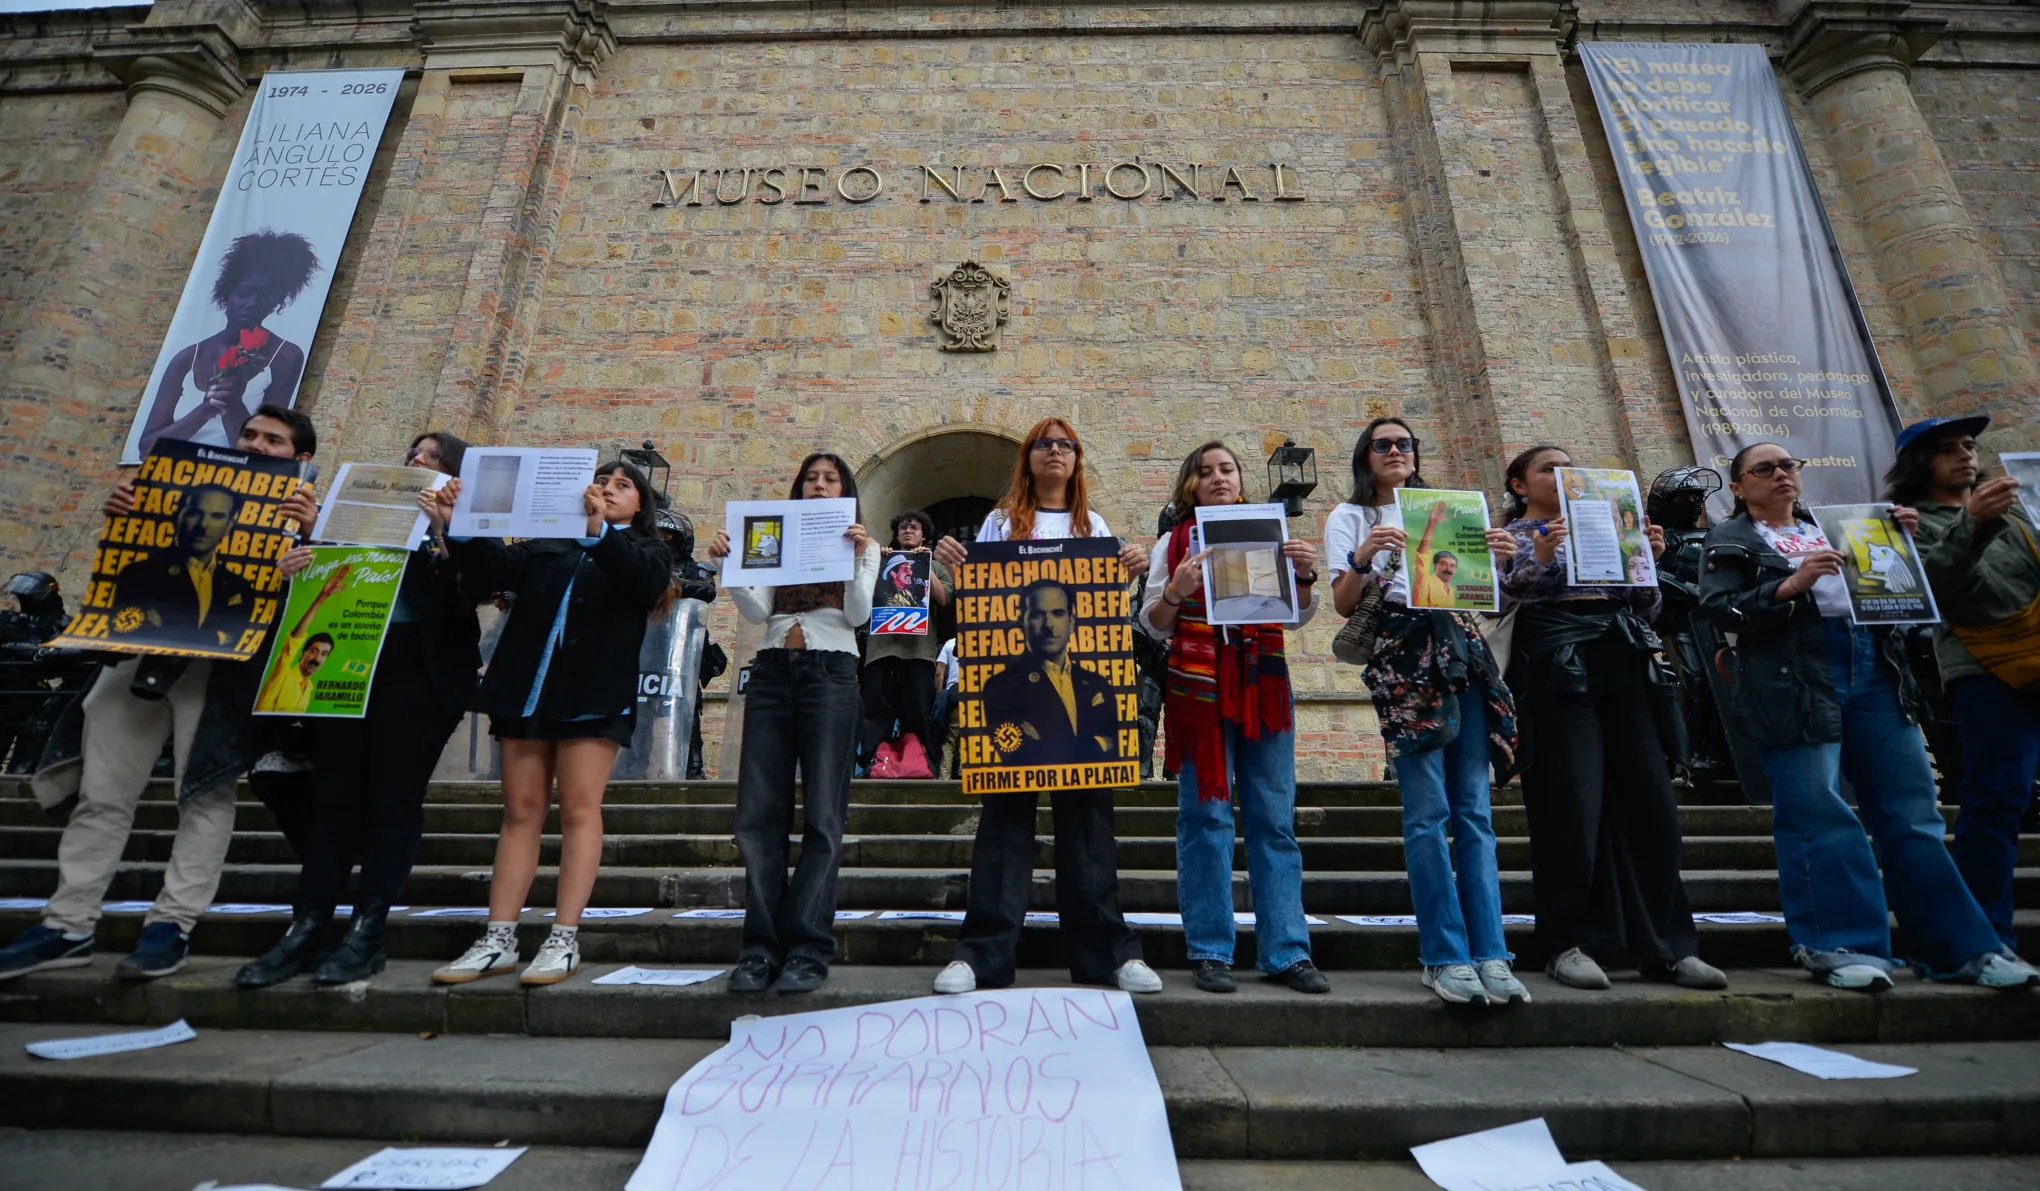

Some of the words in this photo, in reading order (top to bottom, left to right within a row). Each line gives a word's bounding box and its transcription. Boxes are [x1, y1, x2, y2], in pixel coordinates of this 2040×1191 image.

[1646, 60, 1732, 76] museo
[268, 85, 308, 98] 1974
[341, 83, 387, 95] 2026
[1606, 79, 1639, 93] no
[1646, 76, 1712, 94] debe
[1610, 95, 1732, 117] glorificar
[254, 121, 370, 145] LILIANA
[1617, 114, 1641, 134] el
[1650, 115, 1760, 137] pasado,
[1623, 133, 1680, 154] sino
[1686, 134, 1787, 155] hacerlo
[243, 143, 364, 168] ANGULO
[237, 163, 358, 191] CORTÉS
[652, 165, 885, 207] MUSEO
[919, 161, 1307, 204] NACIONAL
[1636, 186, 1742, 207] Beatriz
[1643, 207, 1776, 229] González
[1682, 352, 1731, 365] Artista
[1736, 352, 1801, 368] plástica,
[1686, 369, 1793, 385] investigadora,
[1797, 371, 1870, 386] pedagoga
[1691, 390, 1700, 402] y
[1705, 387, 1775, 401] curadora
[1779, 387, 1802, 400] del
[1806, 387, 1852, 401] Museo
[1695, 405, 1764, 419] Nacional
[1768, 405, 1789, 418] de
[1793, 405, 1864, 419] Colombia
[1701, 422, 1790, 438] (1989-2004)
[342, 609, 385, 619] Colombia
[356, 599, 389, 612] Porque
[354, 622, 382, 630] sueño
[337, 632, 349, 640] de
[316, 680, 366, 691] BERNARDO
[967, 771, 1020, 793] ¡FIRME
[1025, 769, 1057, 789] POR
[1062, 768, 1081, 787] LA
[1085, 765, 1135, 784] PLATA!
[724, 1025, 826, 1063] NO
[681, 1052, 1081, 1123] BORRARNOS
